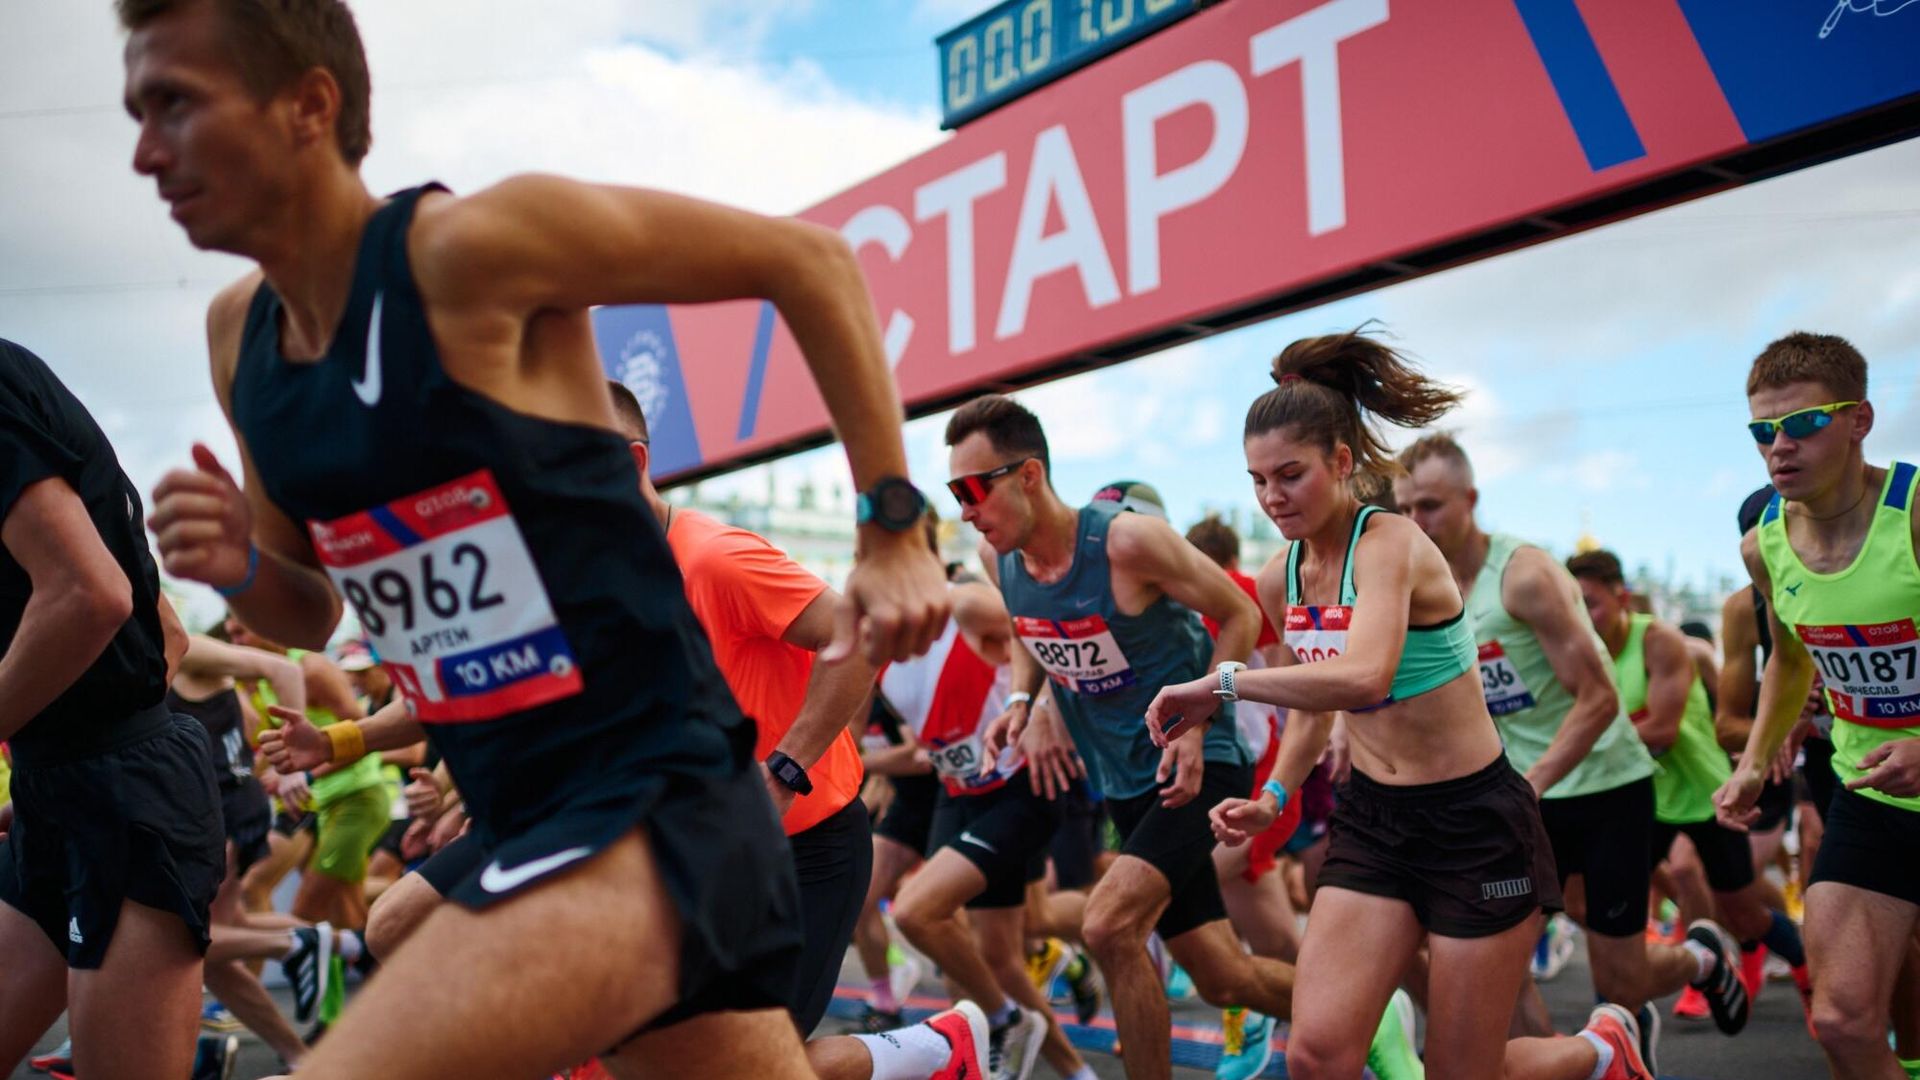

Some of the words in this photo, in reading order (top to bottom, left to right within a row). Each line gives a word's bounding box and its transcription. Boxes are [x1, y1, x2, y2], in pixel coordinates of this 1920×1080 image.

[842, 0, 1390, 374] СТАРТ
[342, 542, 505, 637] 8962
[410, 628, 470, 656] АРТЕМ
[1034, 641, 1108, 668] 8872
[455, 660, 488, 687] 10
[1480, 662, 1515, 689] 36
[1812, 645, 1917, 684] 10187
[1877, 702, 1895, 714] 10
[1481, 876, 1532, 900] PUMA
